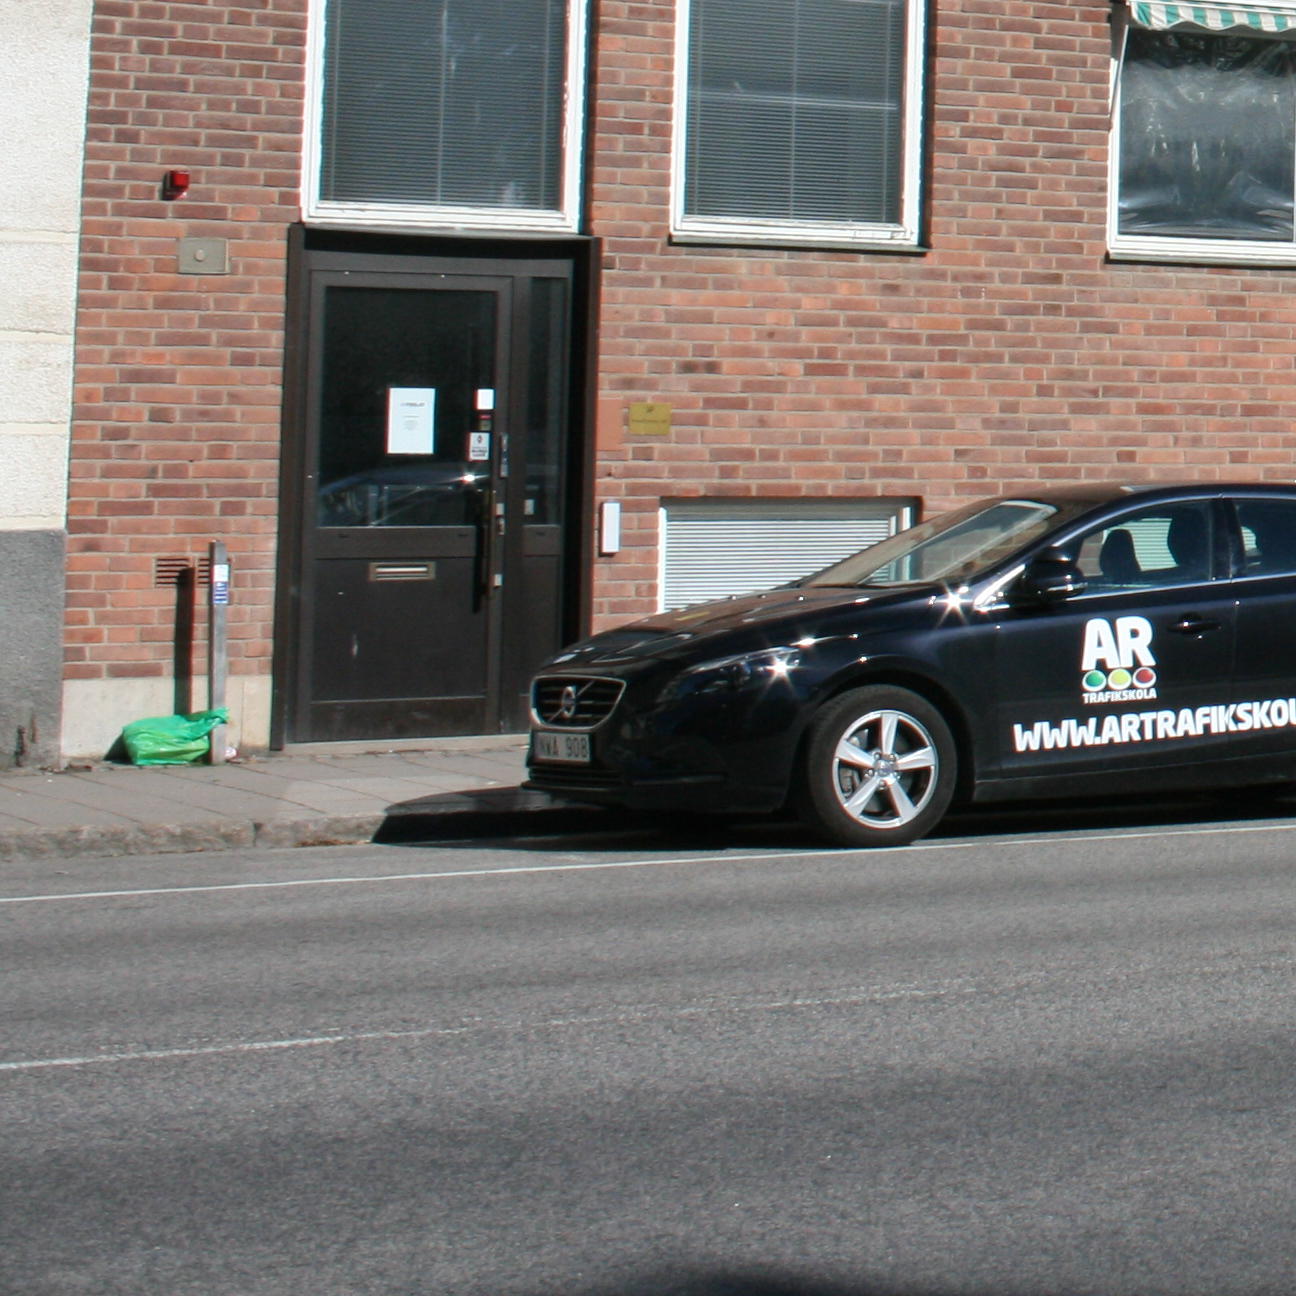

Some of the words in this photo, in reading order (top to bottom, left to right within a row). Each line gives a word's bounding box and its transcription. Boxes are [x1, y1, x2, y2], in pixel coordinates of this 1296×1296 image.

[1082, 616, 1156, 671] AR
[1082, 688, 1157, 704] TRAFIKSKOLA
[566, 736, 588, 758] 908
